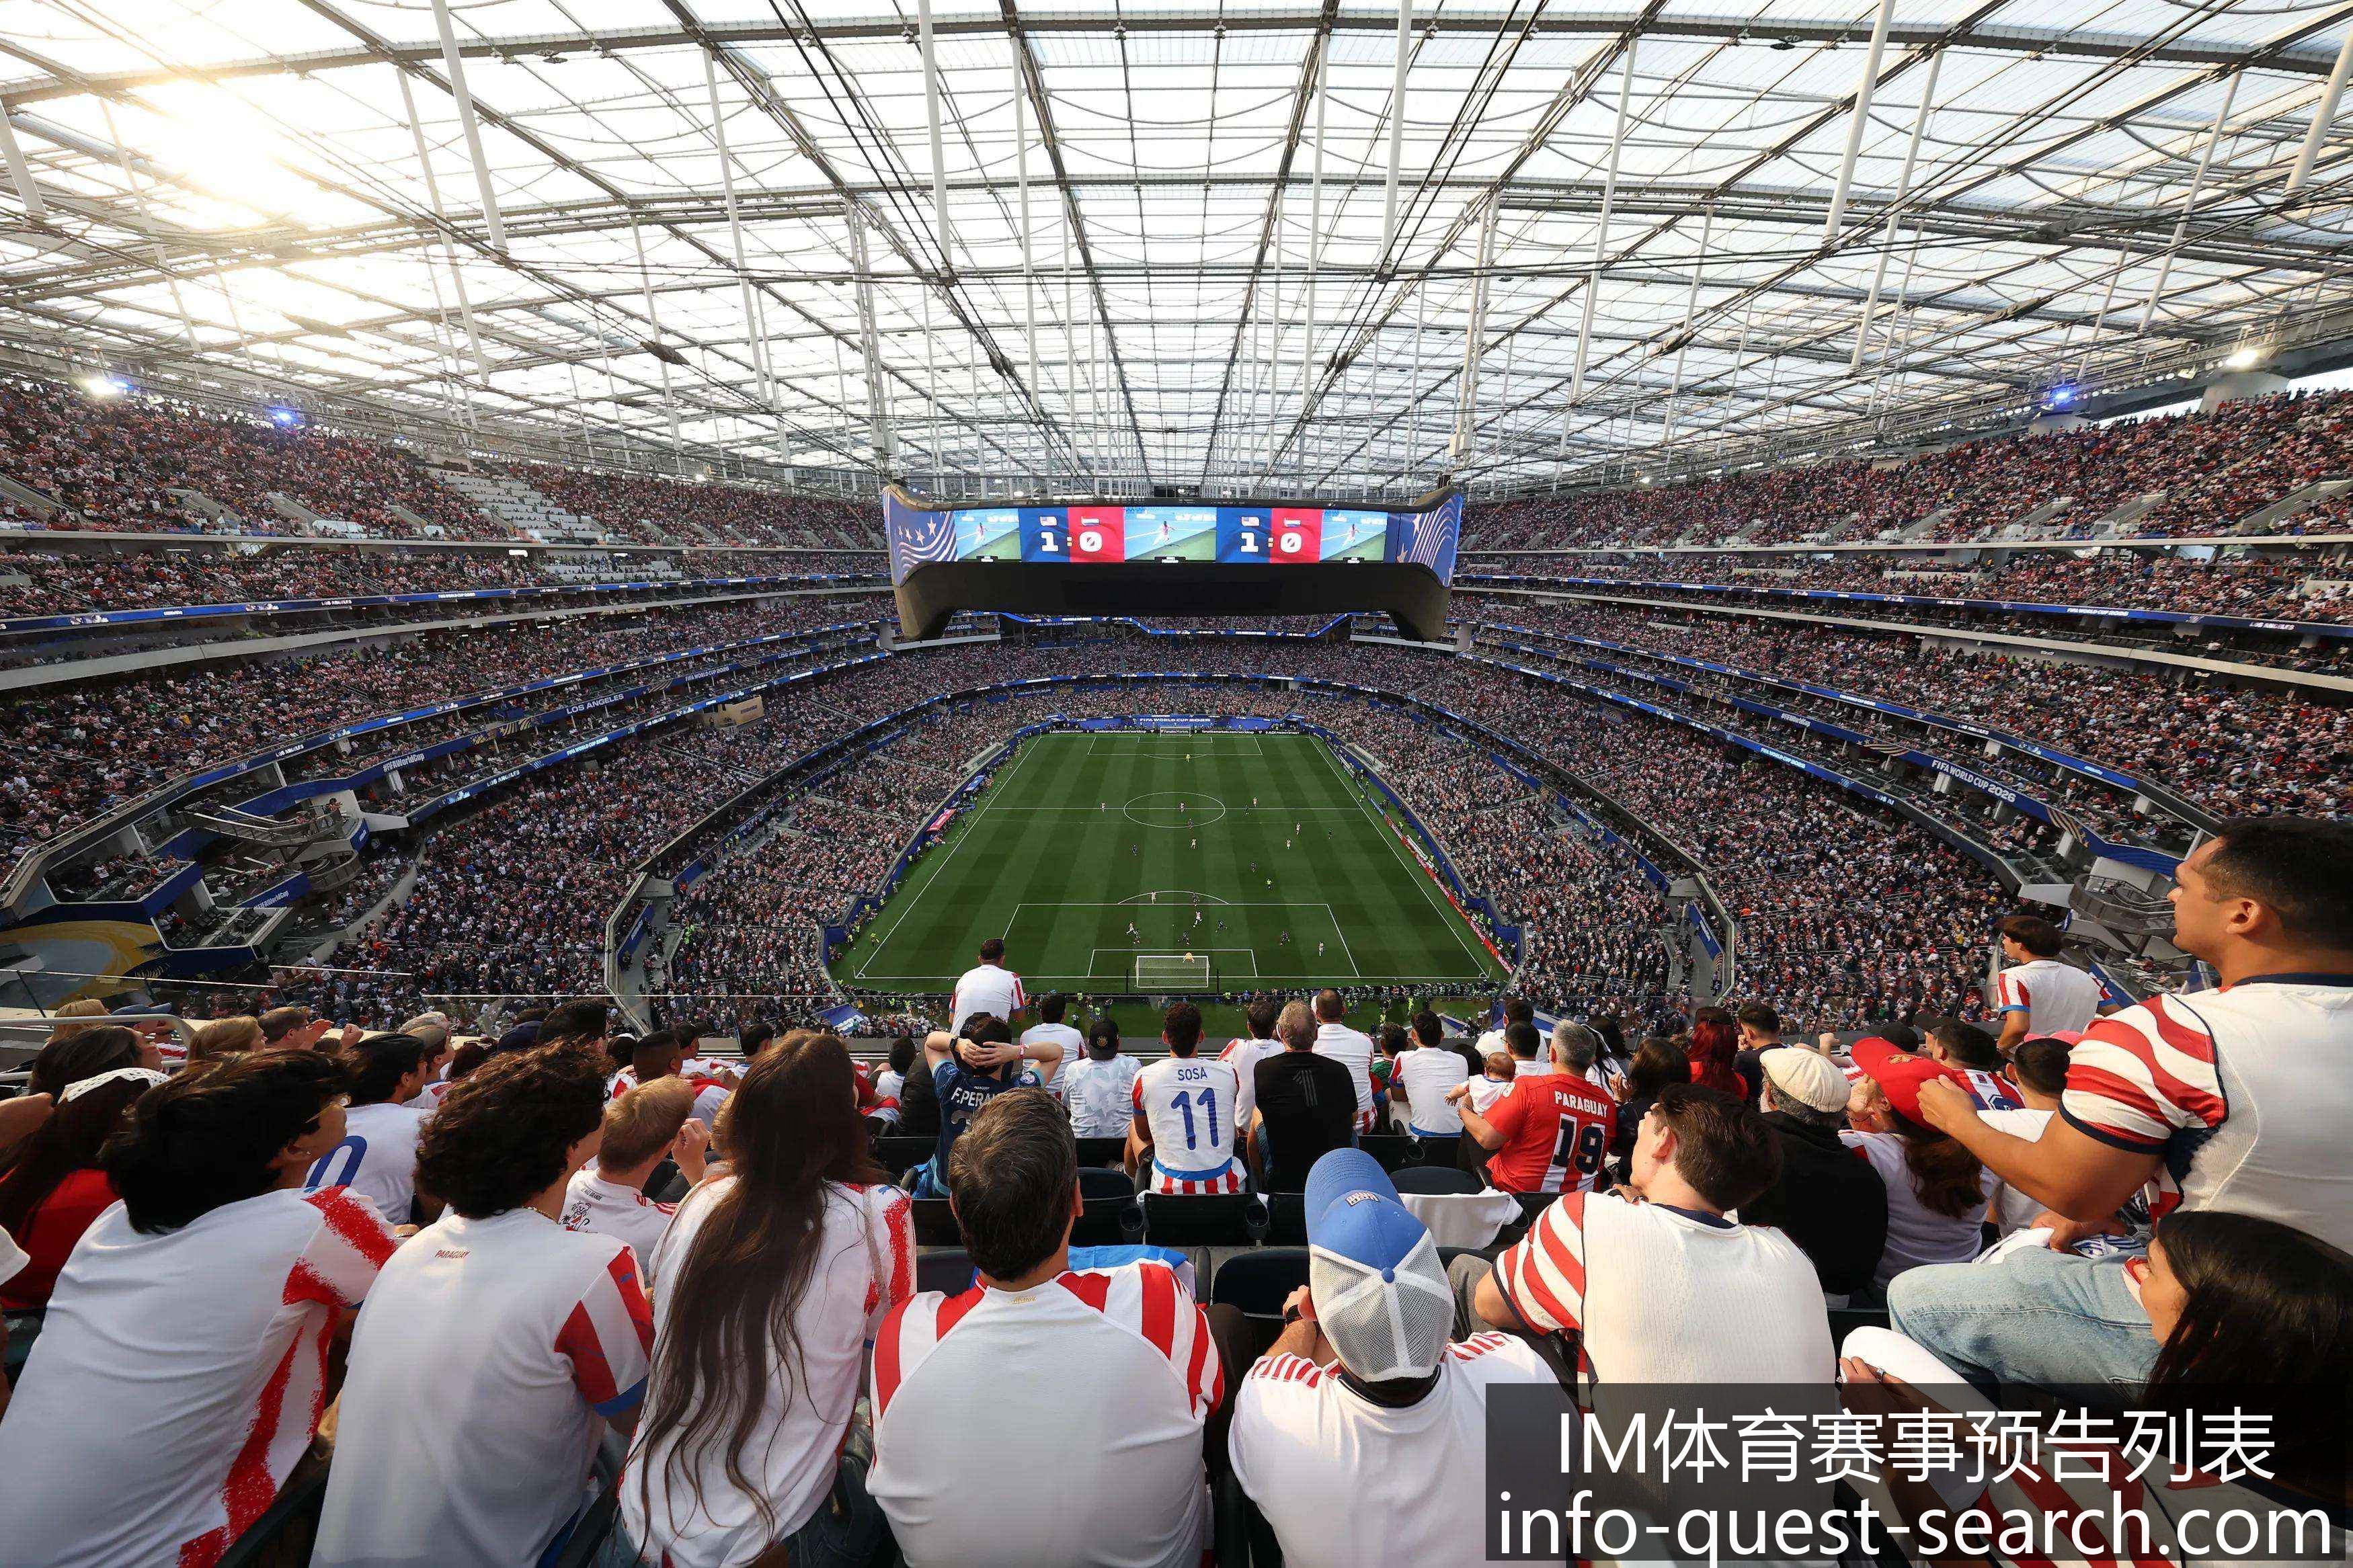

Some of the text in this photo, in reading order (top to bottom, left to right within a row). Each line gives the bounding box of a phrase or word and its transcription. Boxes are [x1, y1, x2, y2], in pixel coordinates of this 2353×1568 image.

[1041, 532, 1059, 551] 1
[1080, 531, 1102, 551] 0
[1240, 532, 1259, 552] 1
[1281, 532, 1302, 552] 0
[1627, 669, 1655, 682] ANGELES
[566, 694, 625, 714] LOS ANGELES
[383, 753, 425, 773] #FIFAWorldCup
[1931, 759, 2017, 802] FIFA WORLD CUP 2026
[1178, 1067, 1209, 1081] SOSA
[951, 1087, 995, 1107] F.PERA
[1554, 1090, 1608, 1118] PARAGUAY
[1170, 1087, 1219, 1151] 11
[1550, 1112, 1606, 1175] 19
[435, 1249, 471, 1258] PARAGUAY
